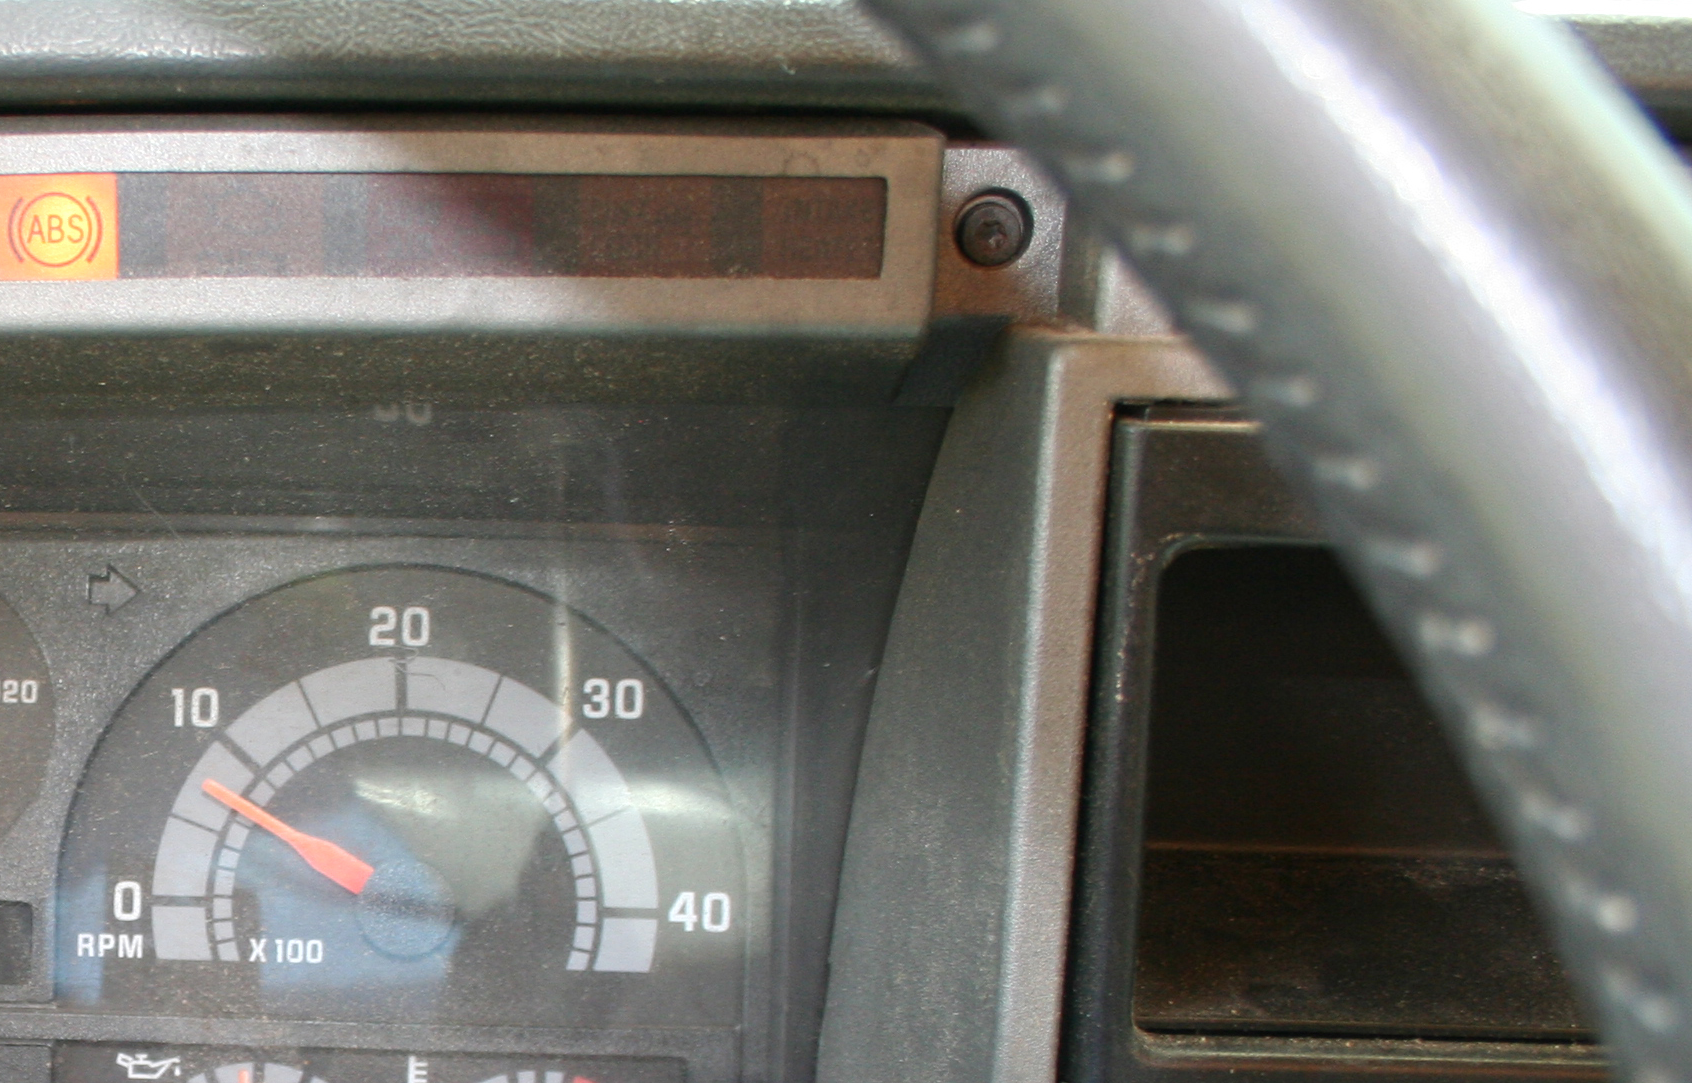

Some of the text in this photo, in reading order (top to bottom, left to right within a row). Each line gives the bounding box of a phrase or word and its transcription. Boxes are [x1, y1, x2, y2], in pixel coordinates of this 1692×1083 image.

[26, 214, 86, 244] ABS
[368, 606, 432, 647] 20
[170, 687, 220, 728] 10
[582, 678, 645, 720] 30
[112, 881, 144, 922] 0
[667, 891, 733, 933] 40
[76, 934, 144, 959] RPM
